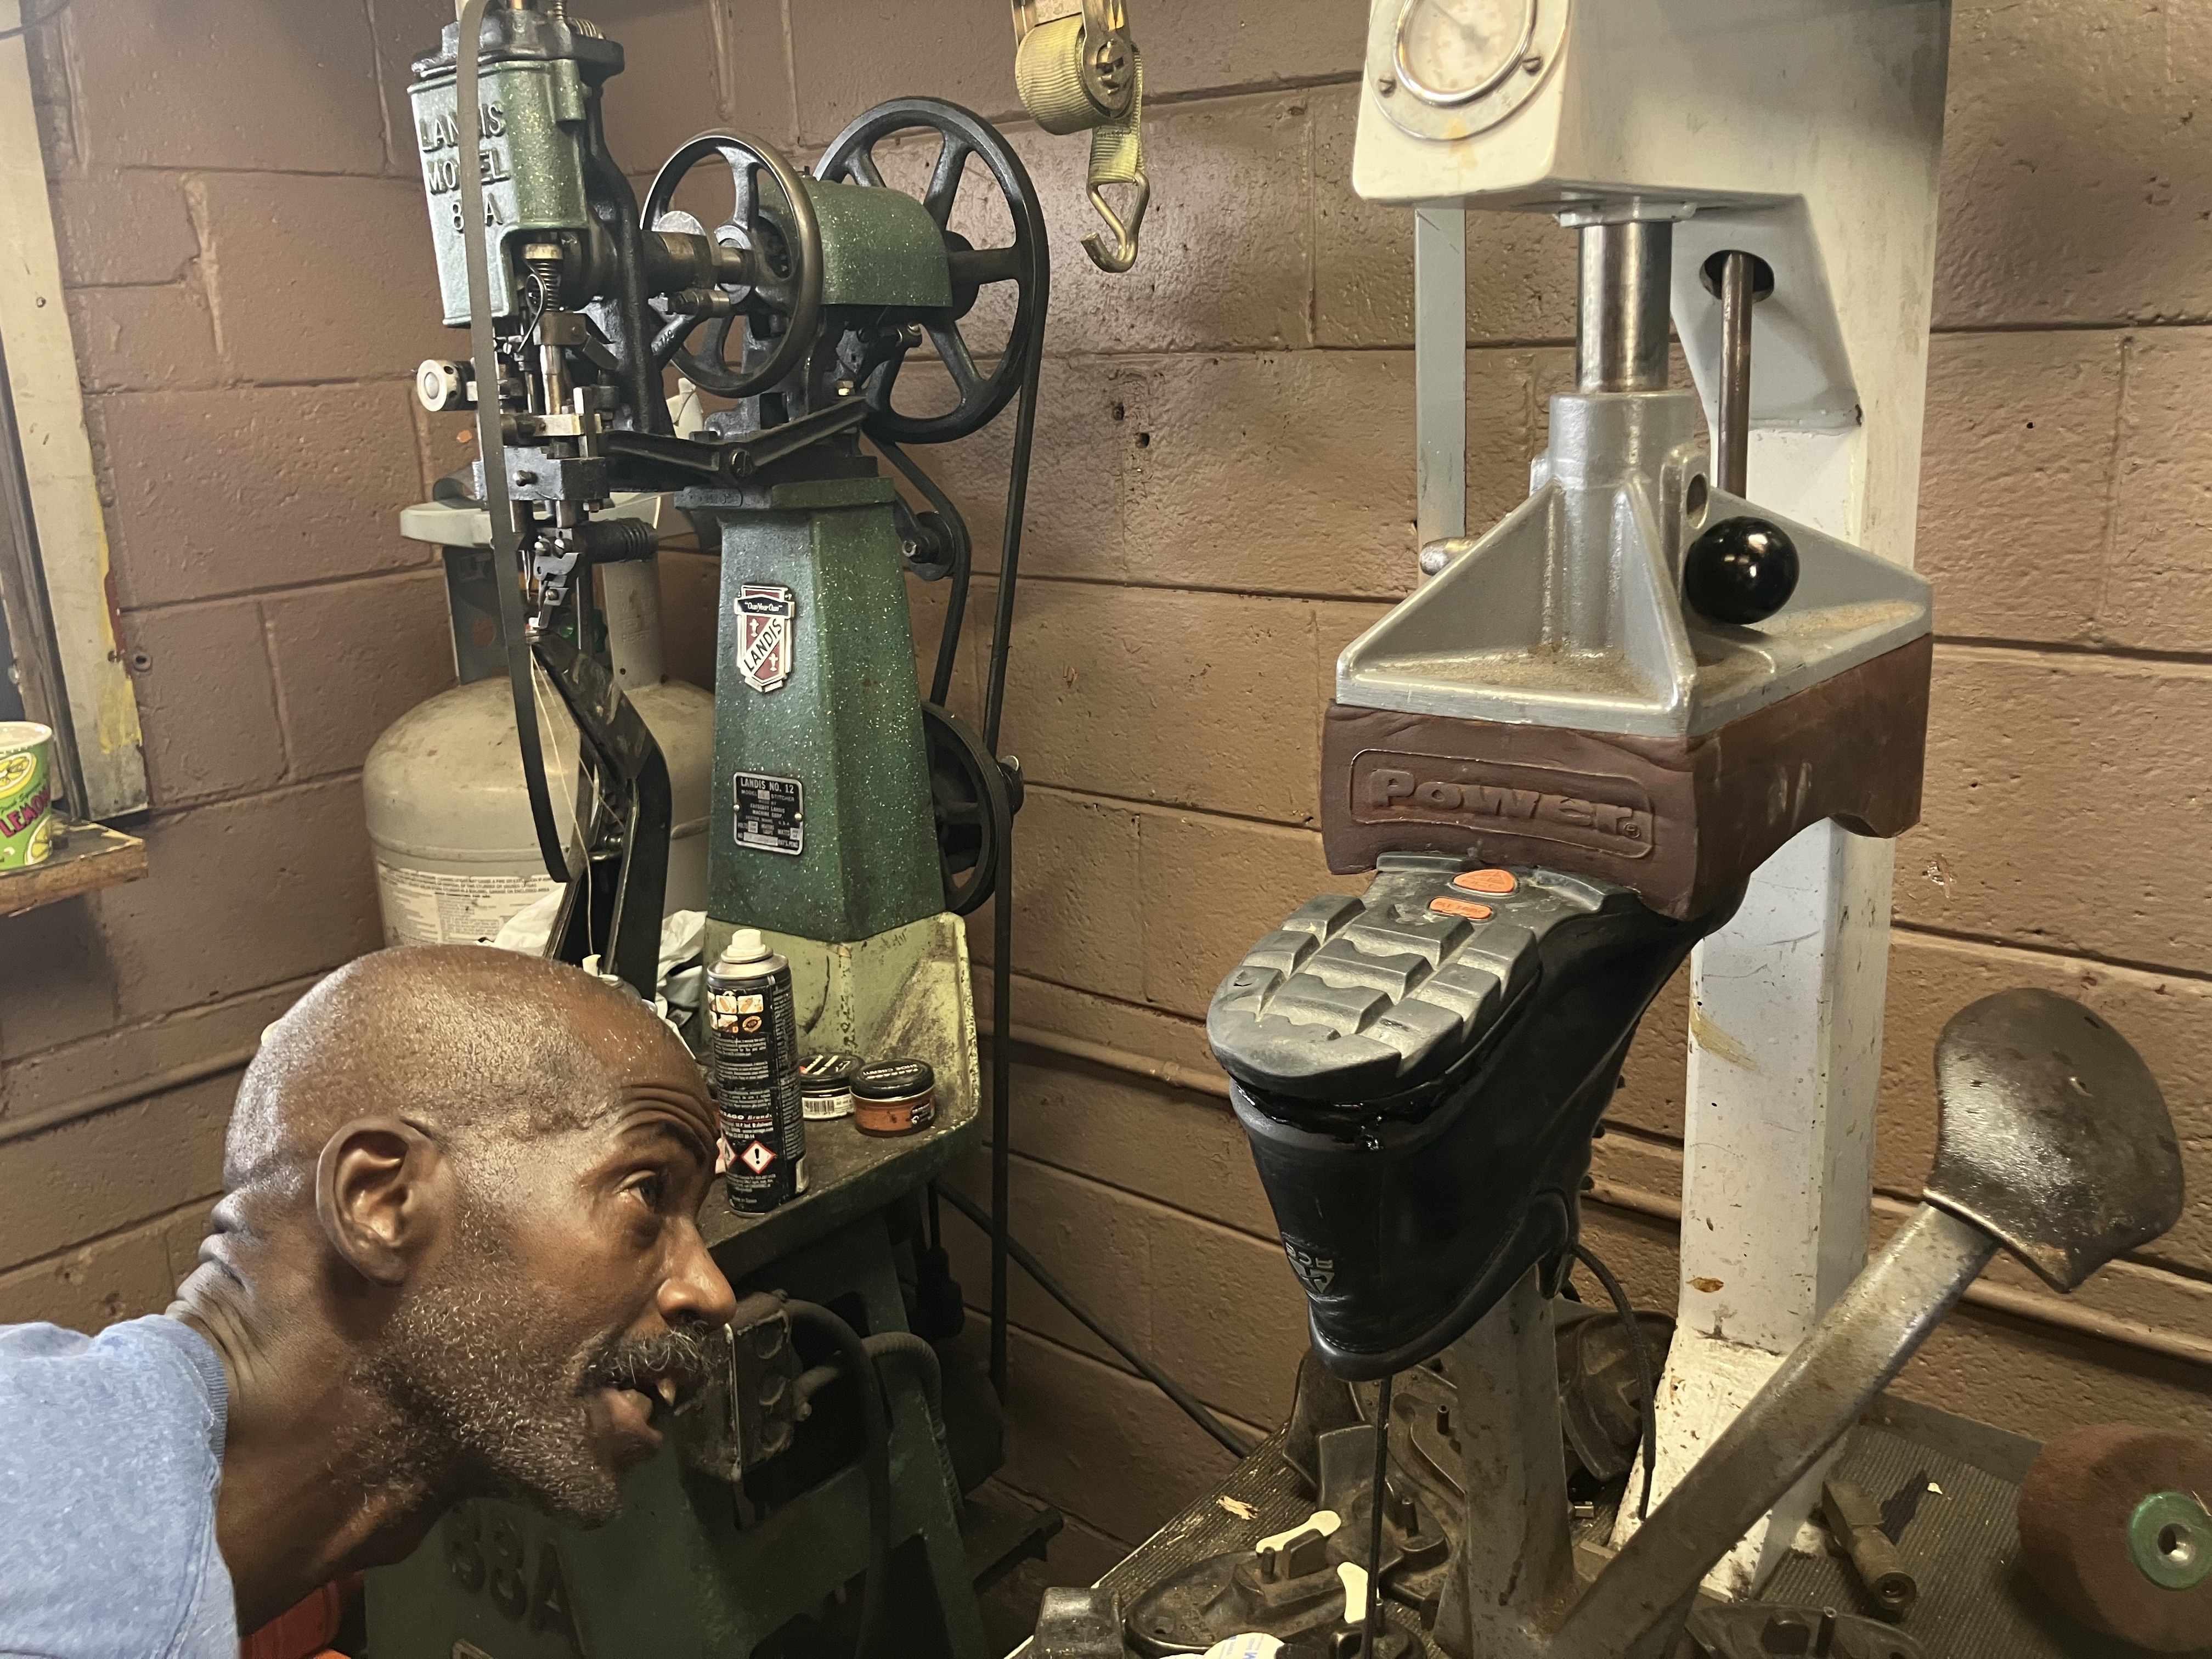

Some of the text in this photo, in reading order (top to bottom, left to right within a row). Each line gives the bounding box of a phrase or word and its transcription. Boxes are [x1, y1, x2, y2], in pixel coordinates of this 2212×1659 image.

[419, 100, 506, 152] LANIS
[426, 147, 511, 195] MOEL
[450, 193, 503, 233] 8A
[743, 618, 782, 672] LANDIS
[741, 777, 794, 794] LANDIS NO. 12
